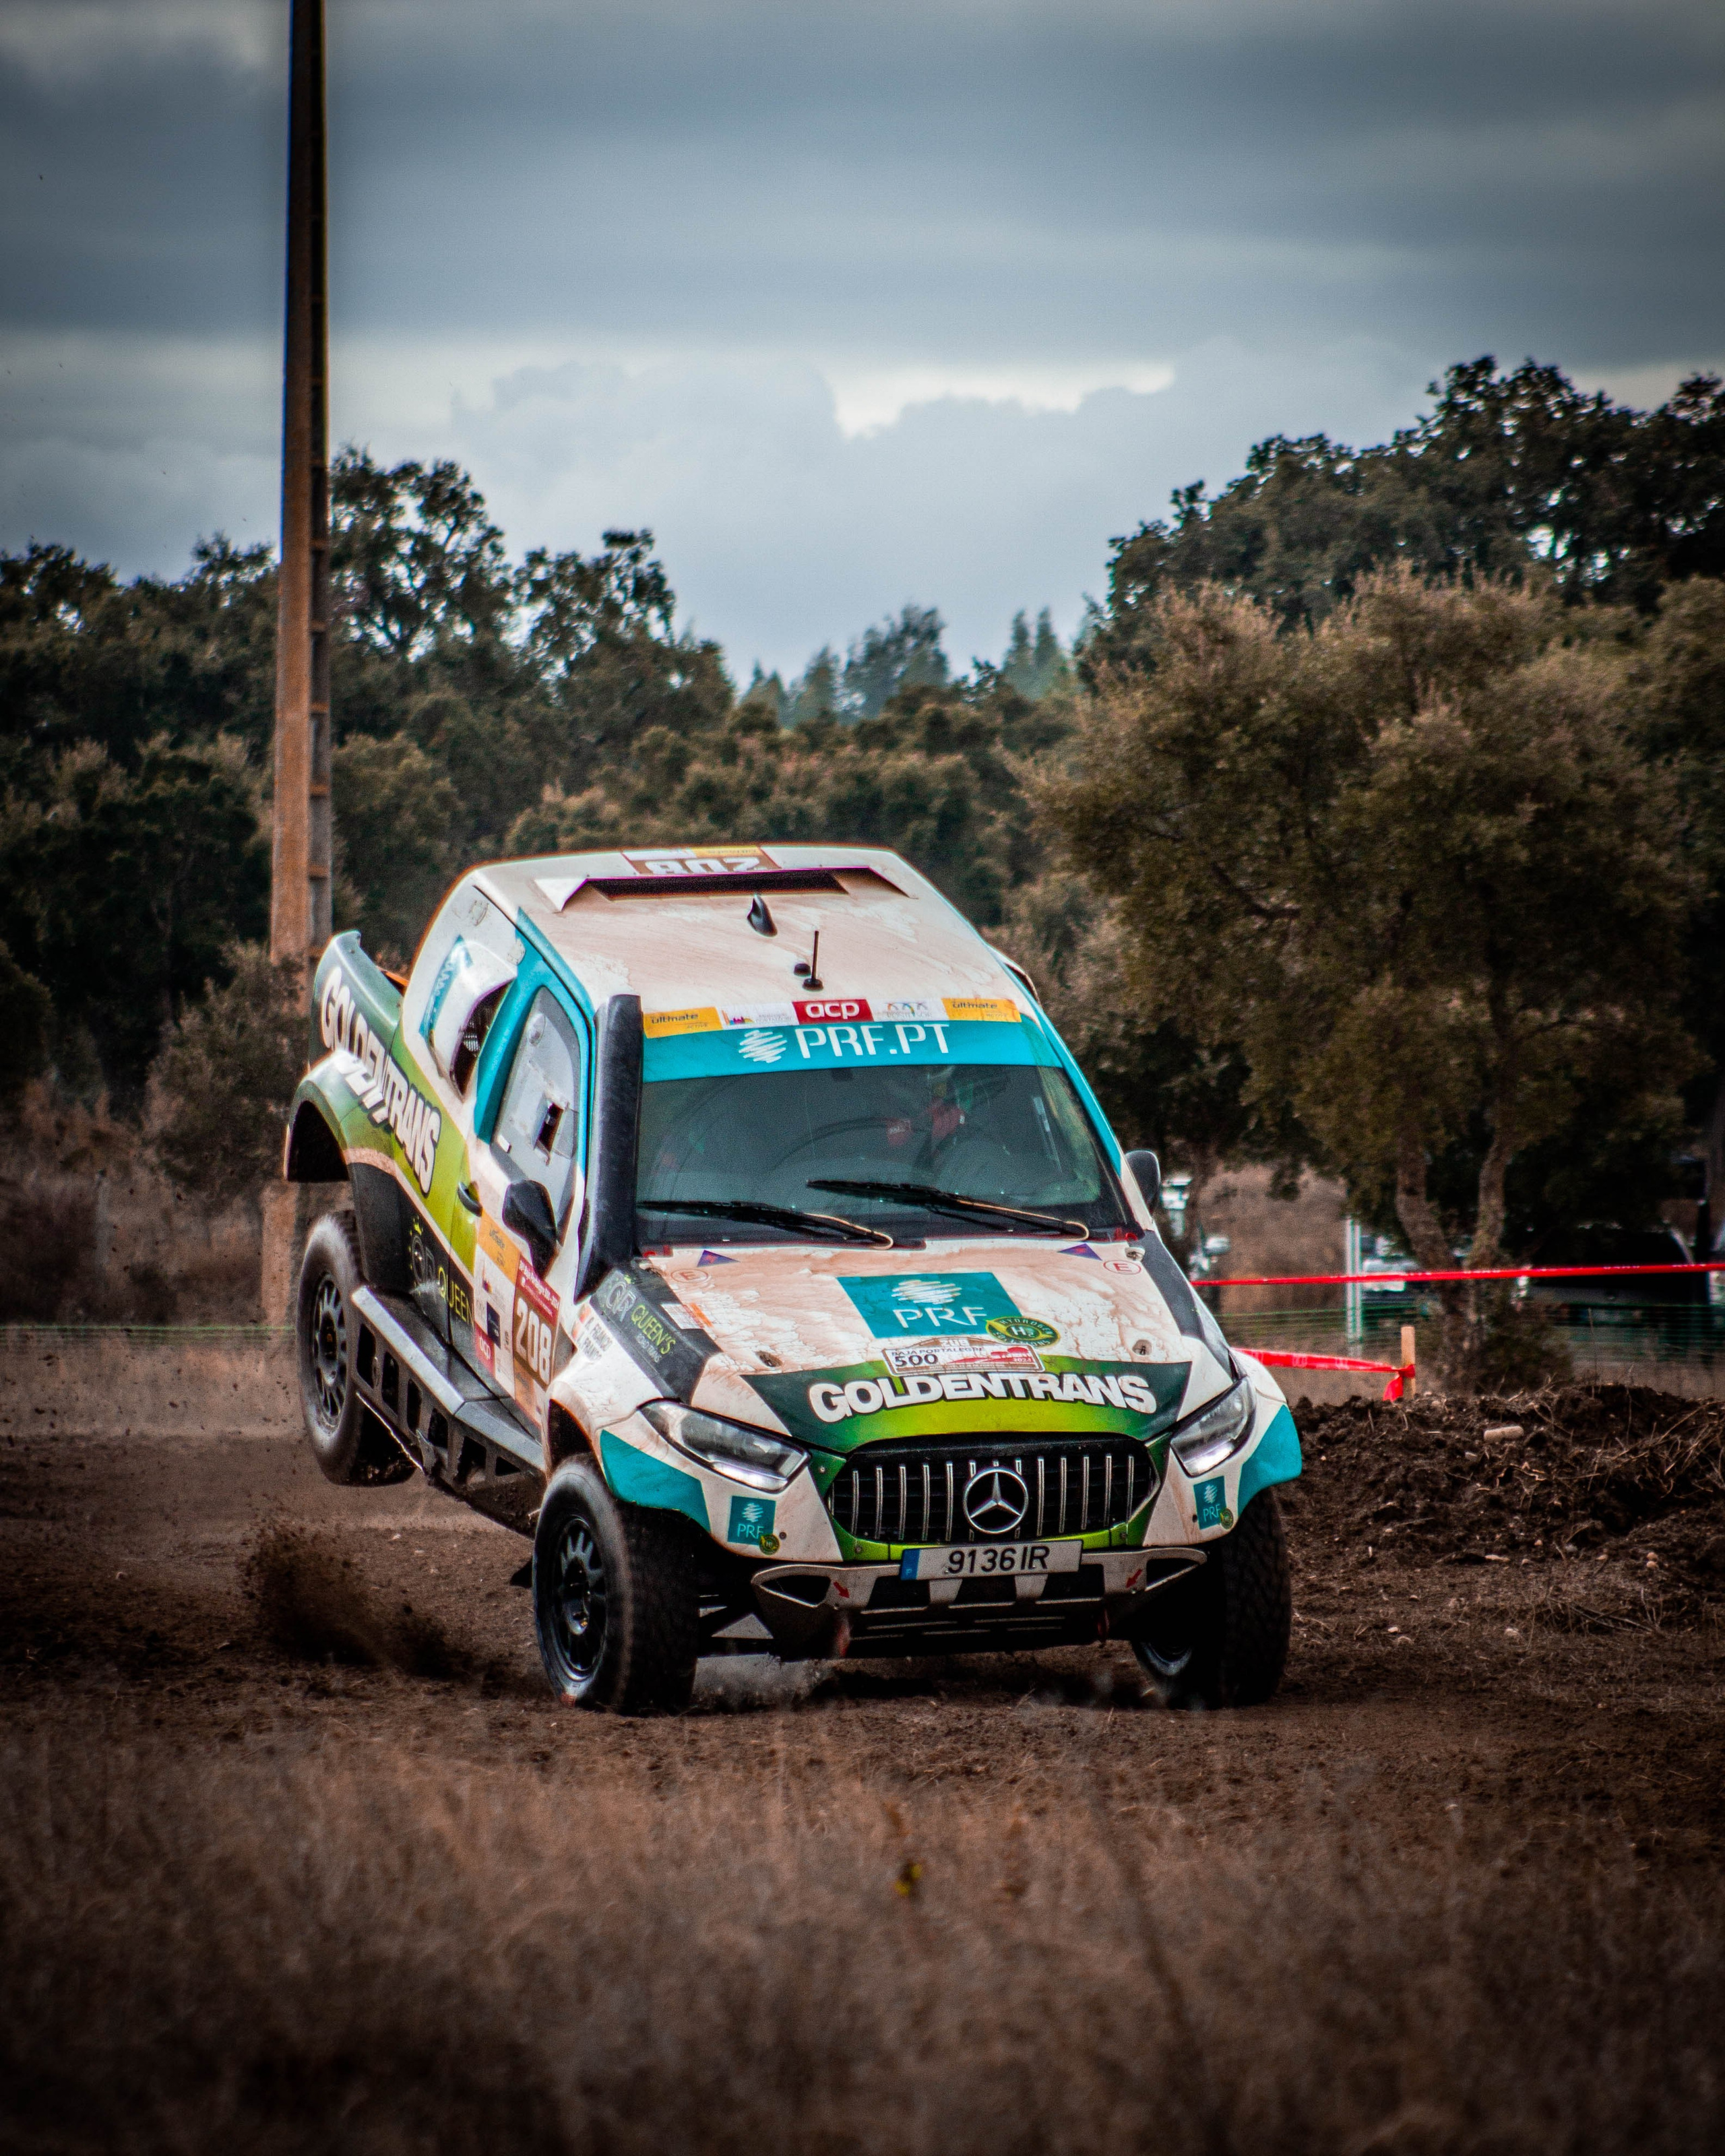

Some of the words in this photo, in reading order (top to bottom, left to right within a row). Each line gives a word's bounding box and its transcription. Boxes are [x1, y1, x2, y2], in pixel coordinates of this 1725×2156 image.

[805, 1002, 860, 1020] acp
[952, 1001, 998, 1009] ultimate
[650, 1013, 699, 1024] ultimate
[794, 1023, 949, 1058] PRF.PT
[892, 1306, 987, 1329] PRF
[631, 1304, 677, 1355] QUEEN'S
[515, 1297, 553, 1385] 208
[894, 1354, 939, 1368] 500
[809, 1372, 1158, 1423] GOLDENTRANS
[1203, 1503, 1220, 1523] PRF
[736, 1523, 765, 1540] PRF
